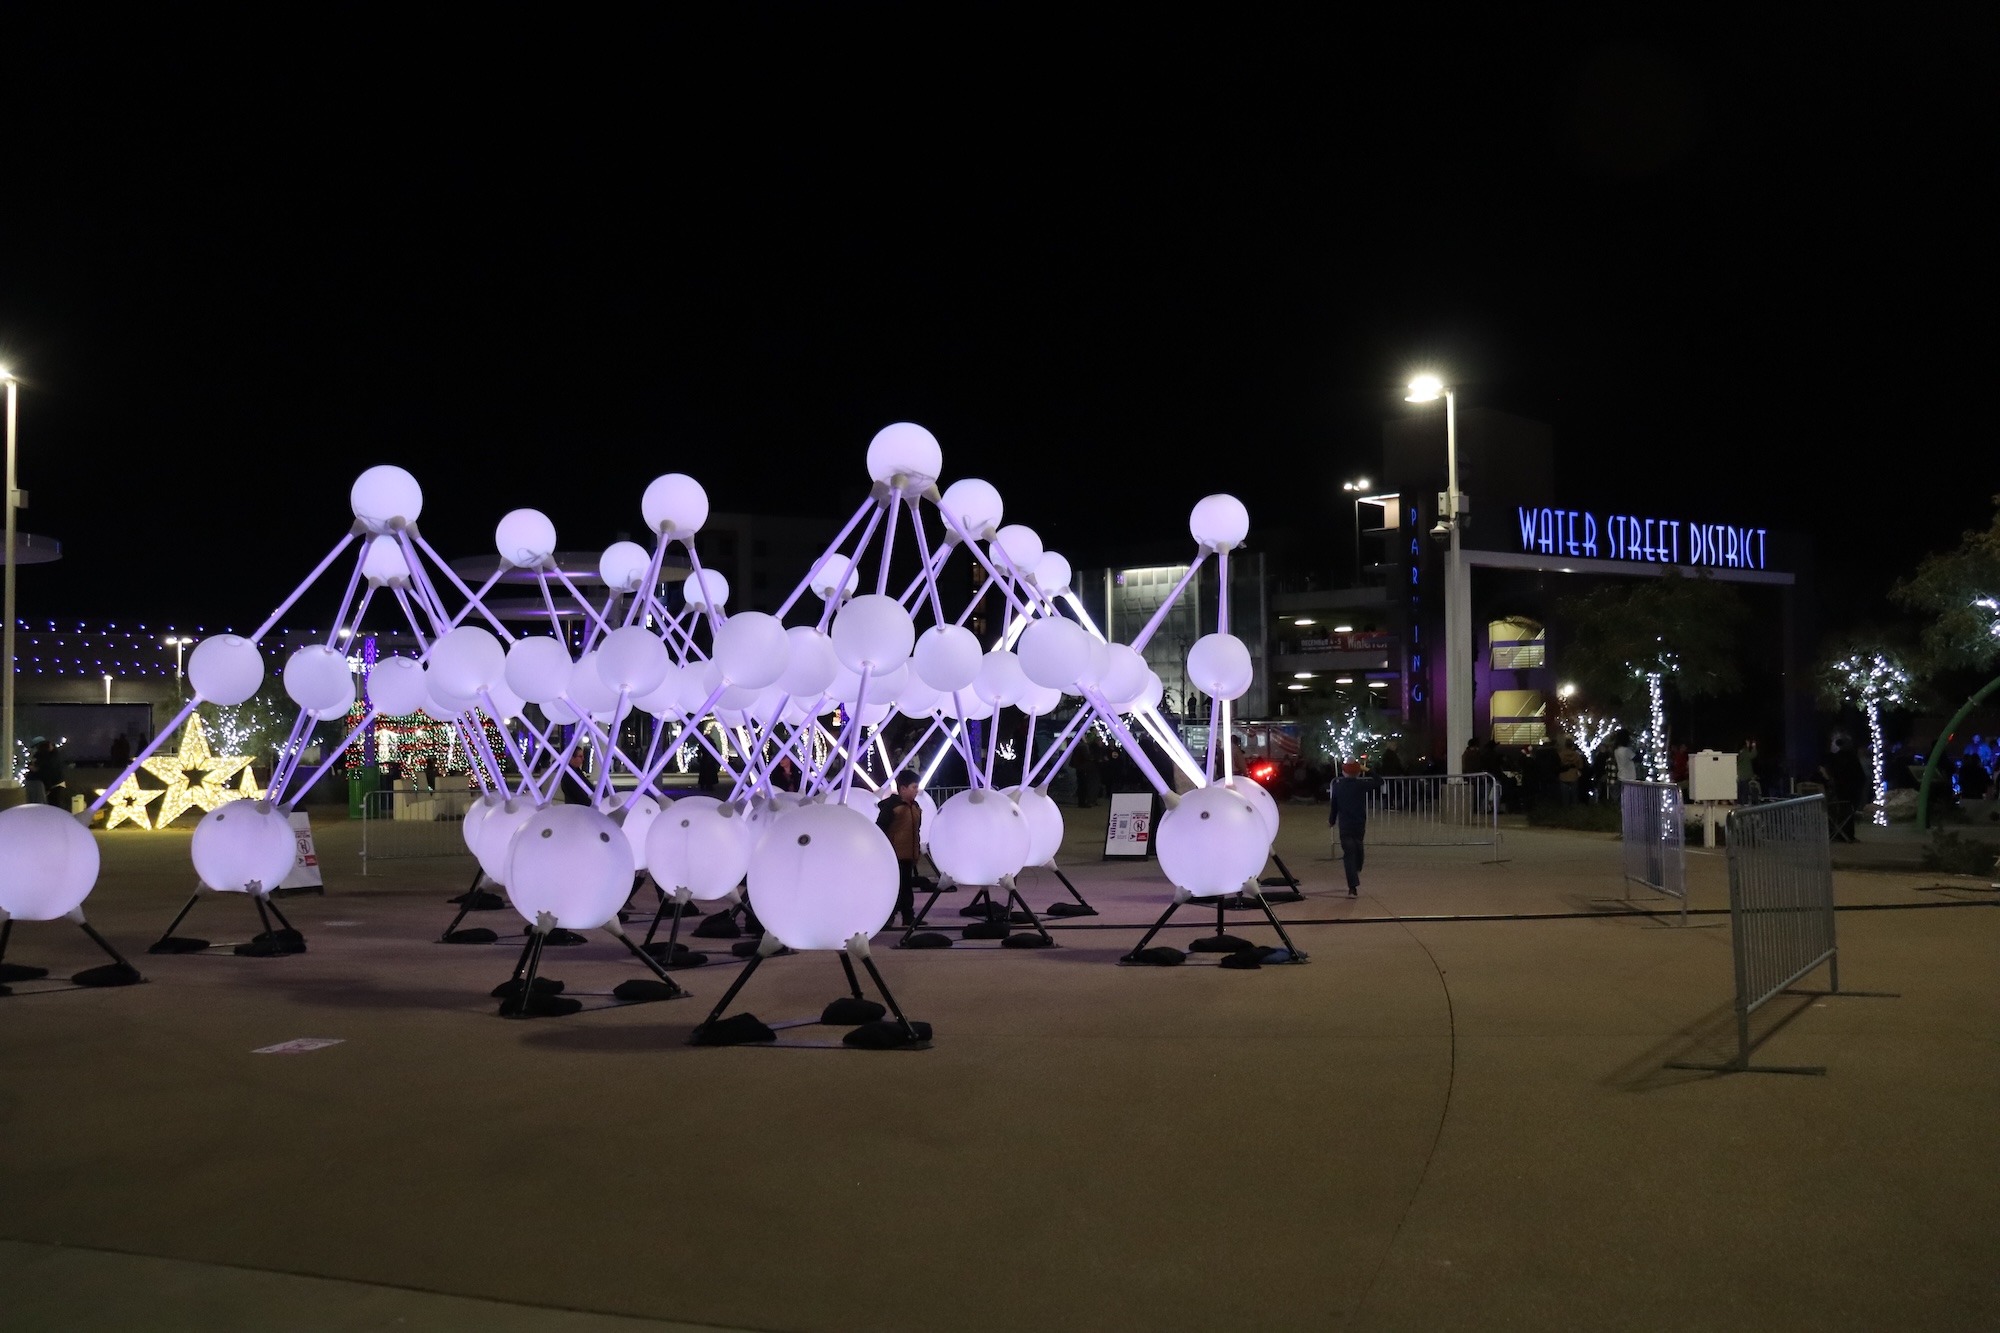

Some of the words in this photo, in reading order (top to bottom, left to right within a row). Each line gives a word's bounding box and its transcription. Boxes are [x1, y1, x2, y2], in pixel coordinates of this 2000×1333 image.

[1518, 506, 1597, 557] WATER
[1607, 515, 1680, 563] STREET
[1690, 522, 1766, 570] DISTRICT
[1411, 507, 1422, 702] PARING
